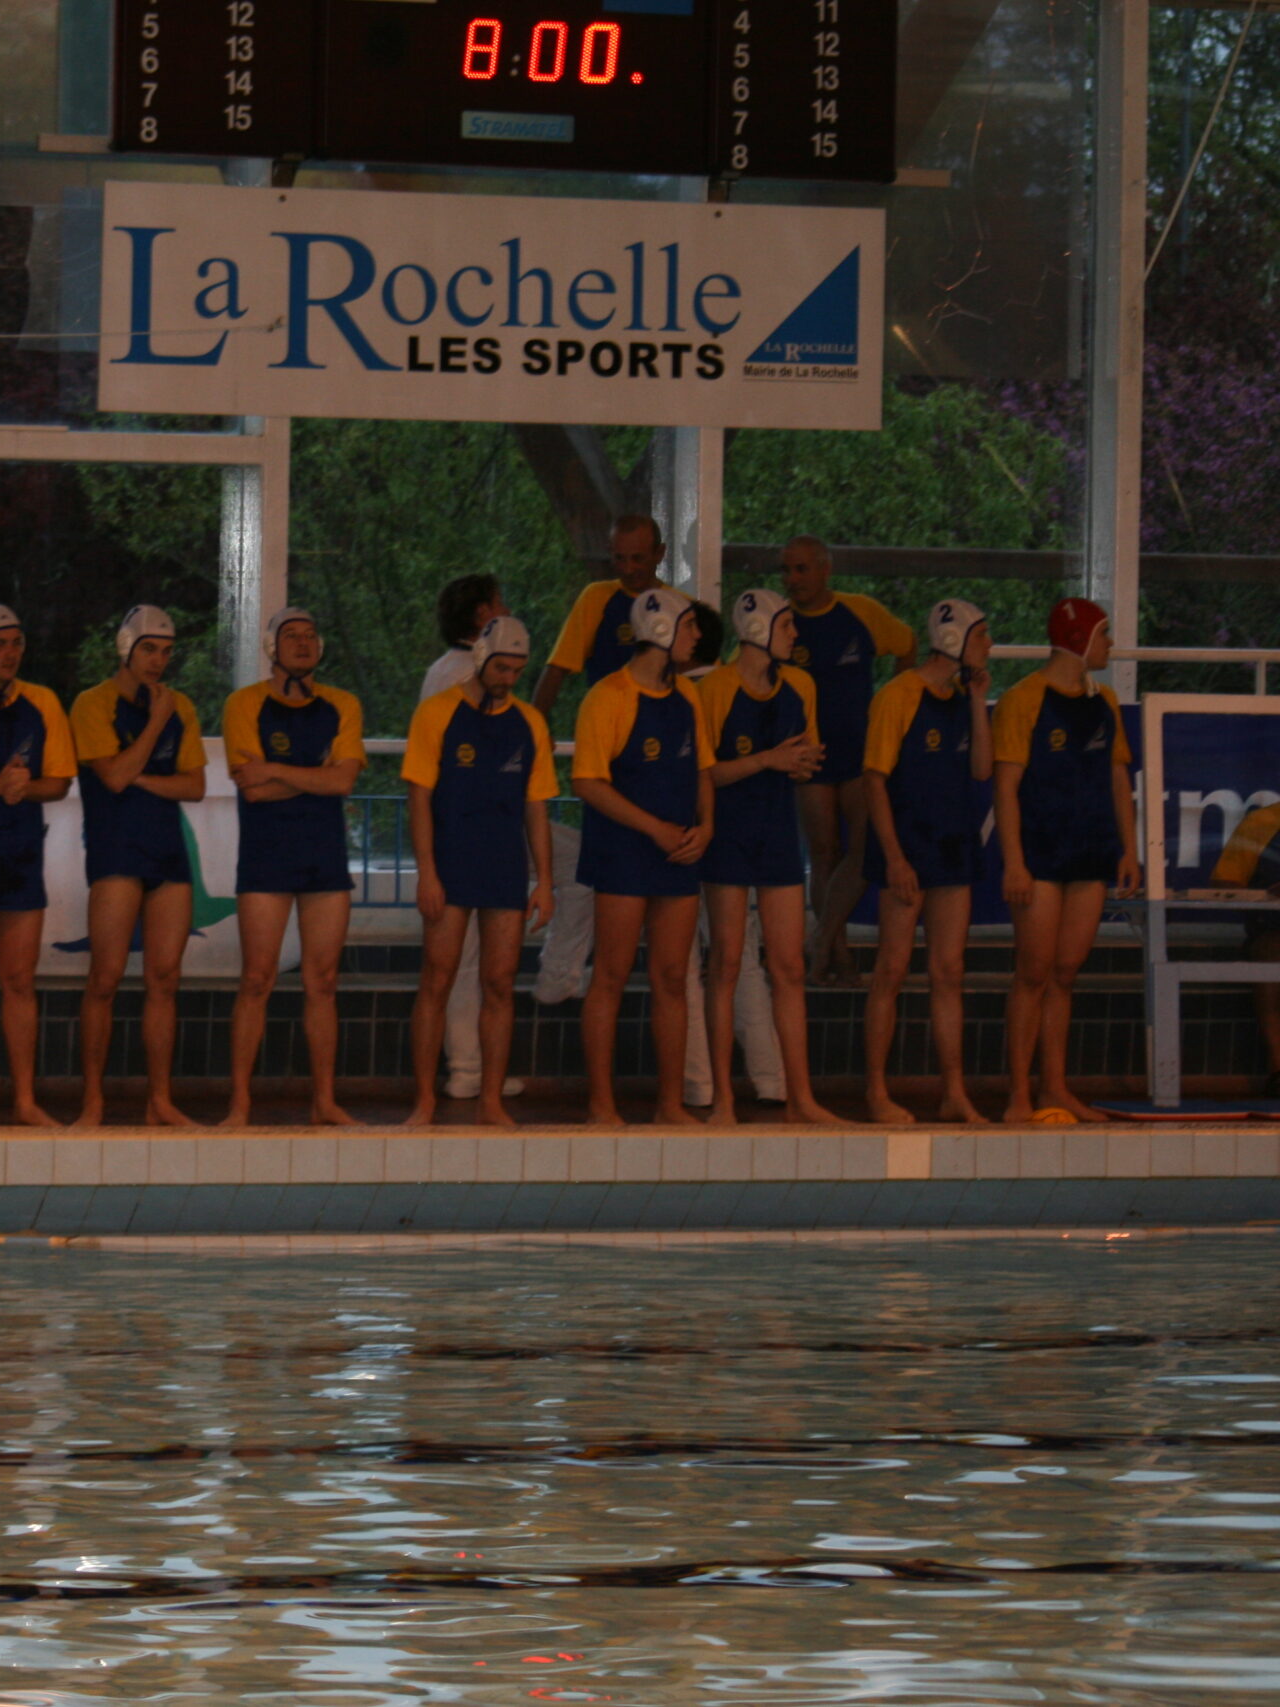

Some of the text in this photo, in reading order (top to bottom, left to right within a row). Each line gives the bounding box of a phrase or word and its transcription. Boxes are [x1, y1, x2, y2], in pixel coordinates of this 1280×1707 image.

[226, 1, 255, 27] 12
[733, 9, 751, 35] 4
[814, 0, 839, 23] 11
[142, 12, 160, 39] 5
[225, 35, 254, 62] 13
[734, 43, 751, 69] 5
[814, 31, 840, 57] 12
[140, 47, 159, 74] 6
[224, 70, 253, 96] 14
[732, 76, 750, 102] 6
[813, 65, 839, 91] 13
[141, 82, 158, 108] 7
[224, 104, 252, 131] 15
[732, 111, 749, 136] 7
[812, 98, 839, 124] 14
[140, 116, 158, 143] 8
[731, 144, 748, 170] 8
[811, 132, 838, 158] 15
[110, 226, 742, 372] La Rochelle
[407, 336, 726, 380] LES SPORTS
[646, 594, 660, 612] 4
[743, 593, 757, 612] 3
[940, 604, 954, 623] 2
[1063, 600, 1077, 621] 1
